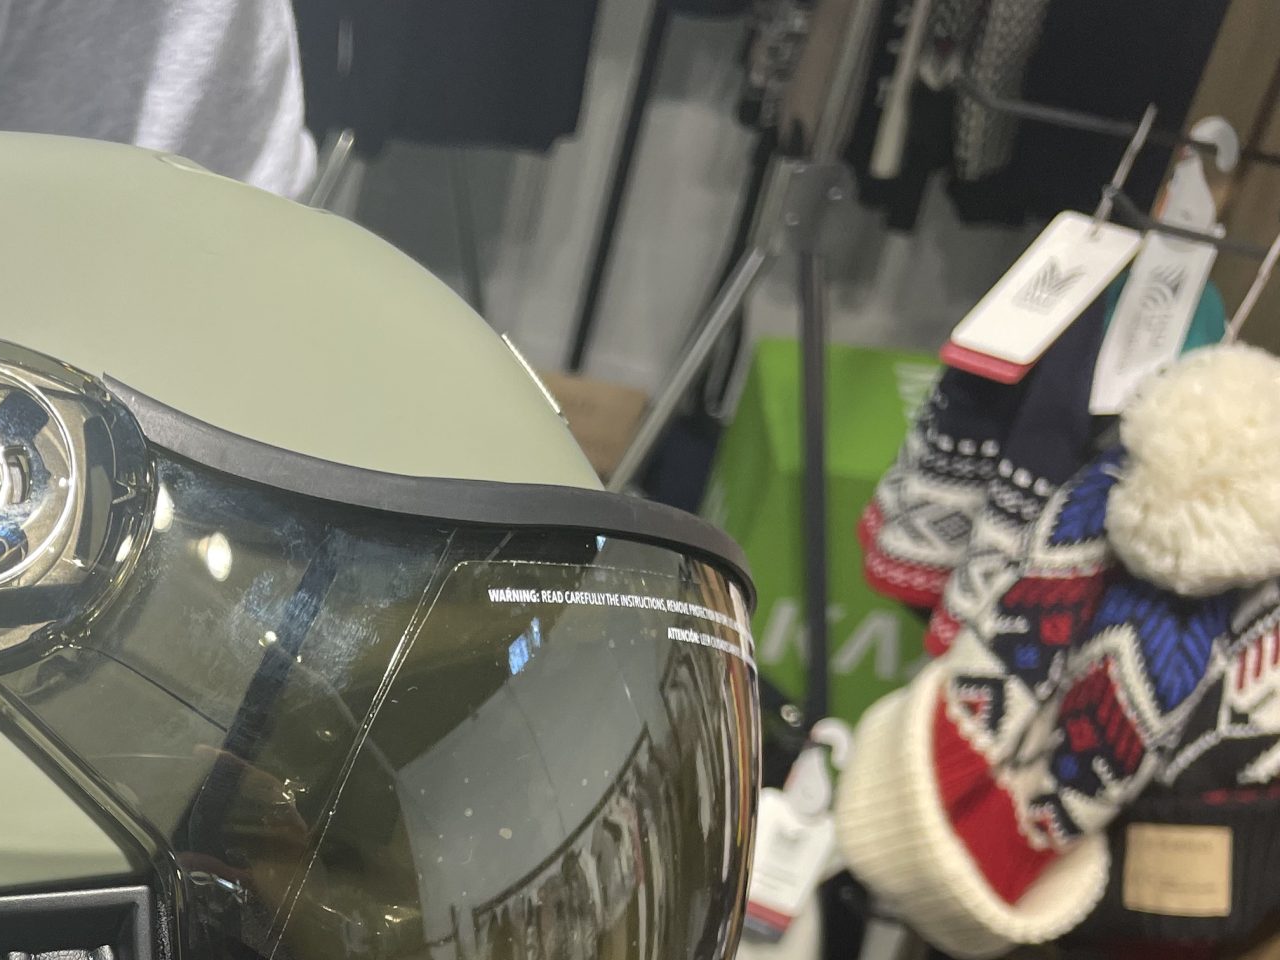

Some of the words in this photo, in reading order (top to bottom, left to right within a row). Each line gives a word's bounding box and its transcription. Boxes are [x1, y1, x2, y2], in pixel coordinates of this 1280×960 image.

[488, 588, 540, 603] WARNING:
[541, 590, 564, 604] READ
[565, 591, 606, 606] CAREFULLY
[607, 593, 620, 607] THE
[621, 594, 668, 613] INSTRUCTIONS,
